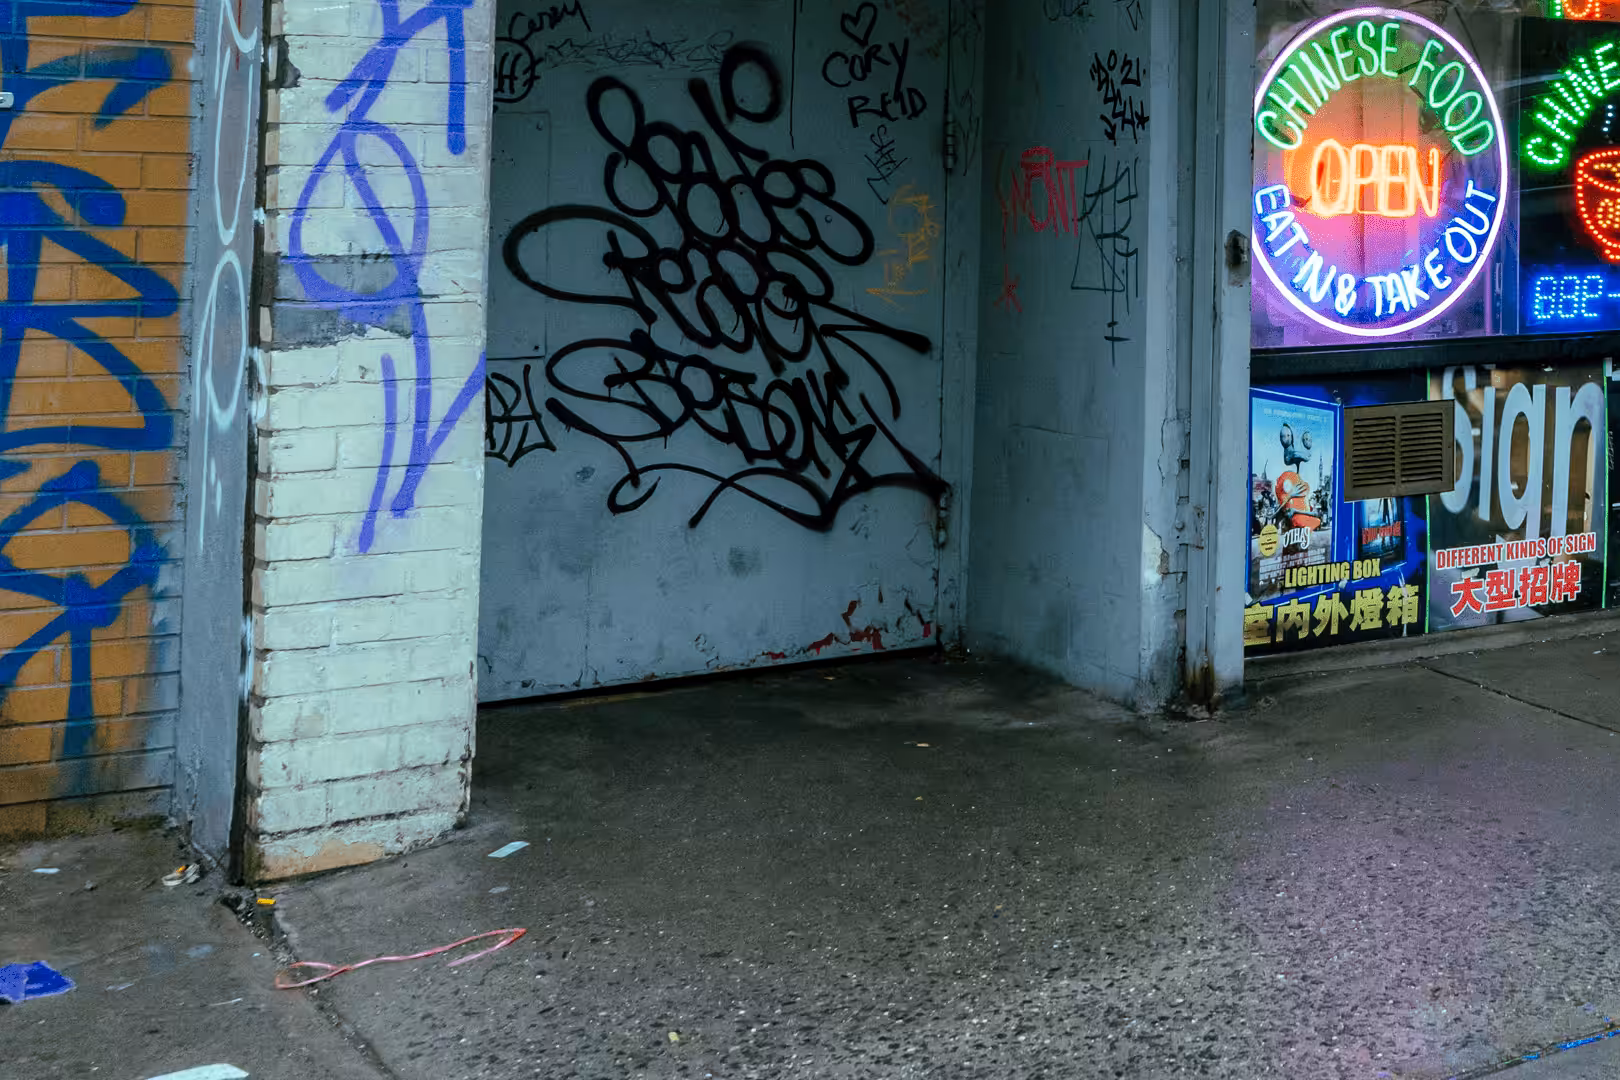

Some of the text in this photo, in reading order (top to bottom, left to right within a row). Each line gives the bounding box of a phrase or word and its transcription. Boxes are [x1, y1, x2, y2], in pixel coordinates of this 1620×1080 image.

[1257, 20, 1400, 152] CHINESE
[1408, 38, 1496, 157] FOOD
[1309, 138, 1440, 219] OPEN
[1254, 183, 1309, 259] EAT
[1294, 250, 1336, 304] IN
[1373, 247, 1452, 318] TAKE
[1445, 179, 1497, 264] OUT
[1284, 561, 1350, 588] LIGHTING
[1352, 558, 1381, 580] BOX
[1436, 532, 1596, 570] DIFFERENT KINDS OF SIGN
[1450, 560, 1582, 617] 大型招牌
